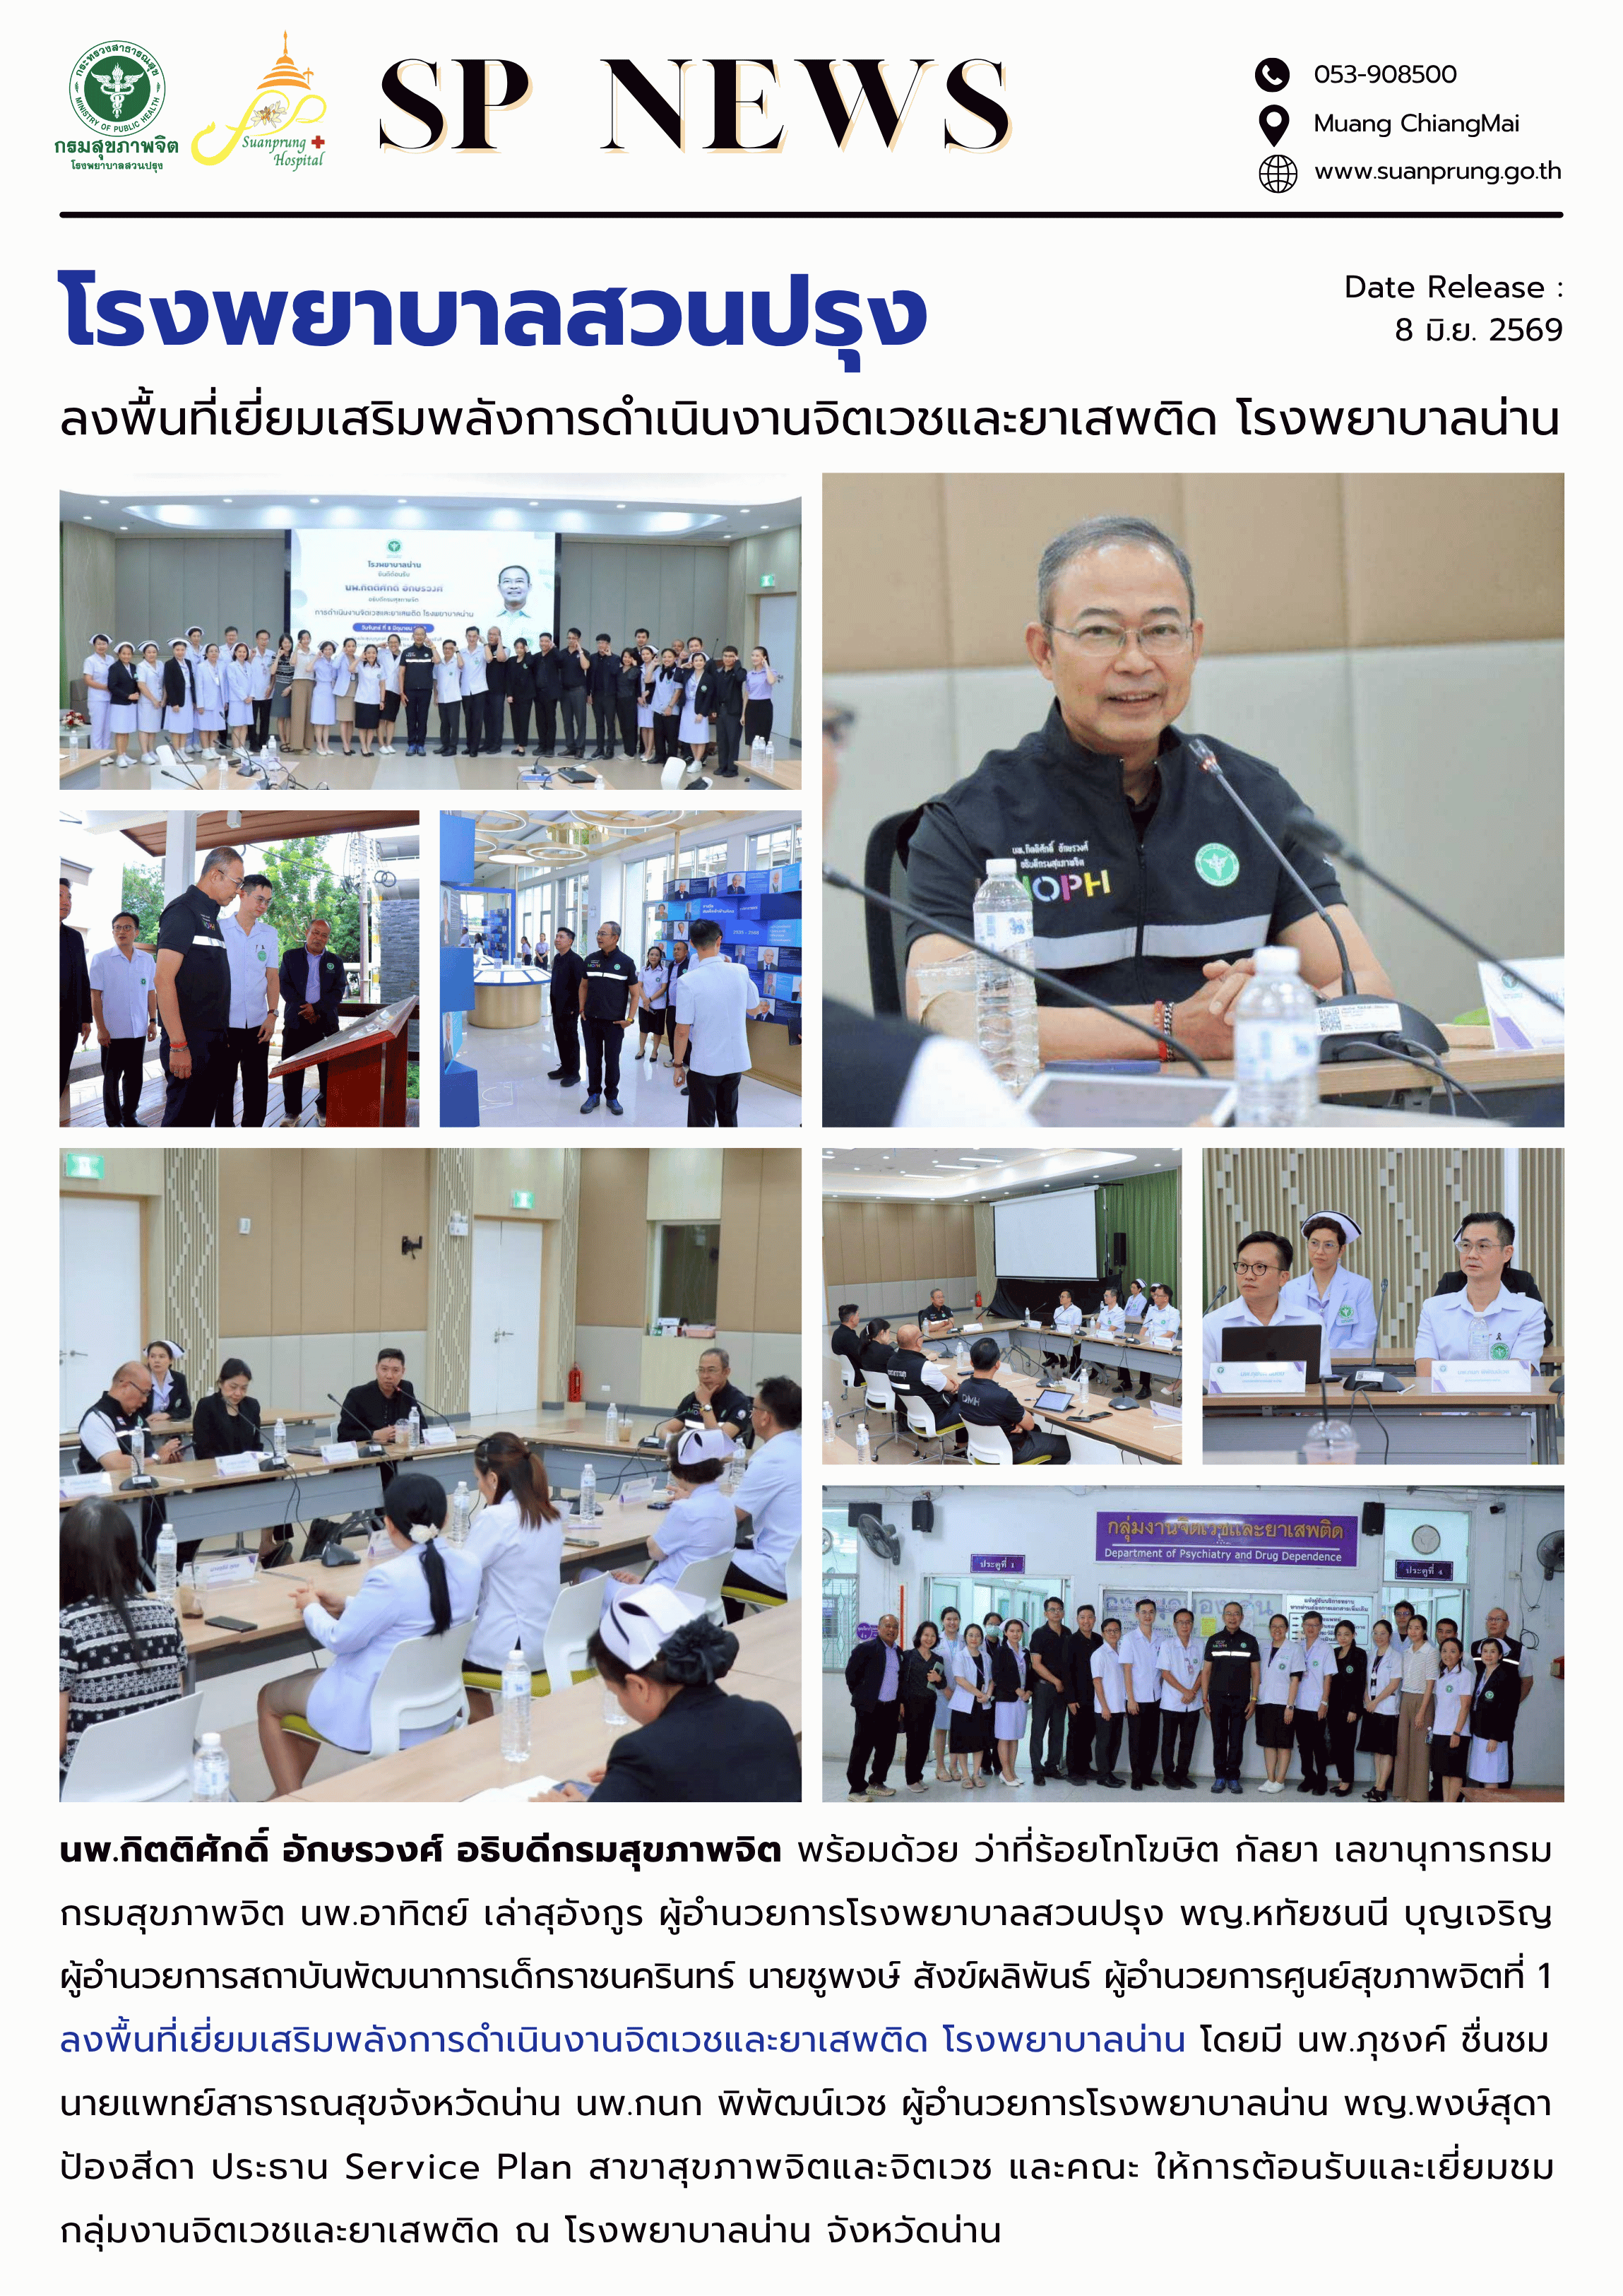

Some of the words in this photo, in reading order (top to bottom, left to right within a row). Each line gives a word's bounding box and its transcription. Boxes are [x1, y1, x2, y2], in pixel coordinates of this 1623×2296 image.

[1108, 1515, 1344, 1543] กลุ่มงานจิตเวชและยาเสพติด
[1105, 1548, 1163, 1559] Department
[1166, 1549, 1177, 1558] of
[1179, 1549, 1232, 1561] Psychiatry
[1235, 1551, 1252, 1560] and
[1255, 1551, 1278, 1562] Drug
[1282, 1551, 1342, 1562] Dependence
[980, 1557, 1006, 1570] ประตูที่
[1405, 1563, 1434, 1578] ประตูที่
